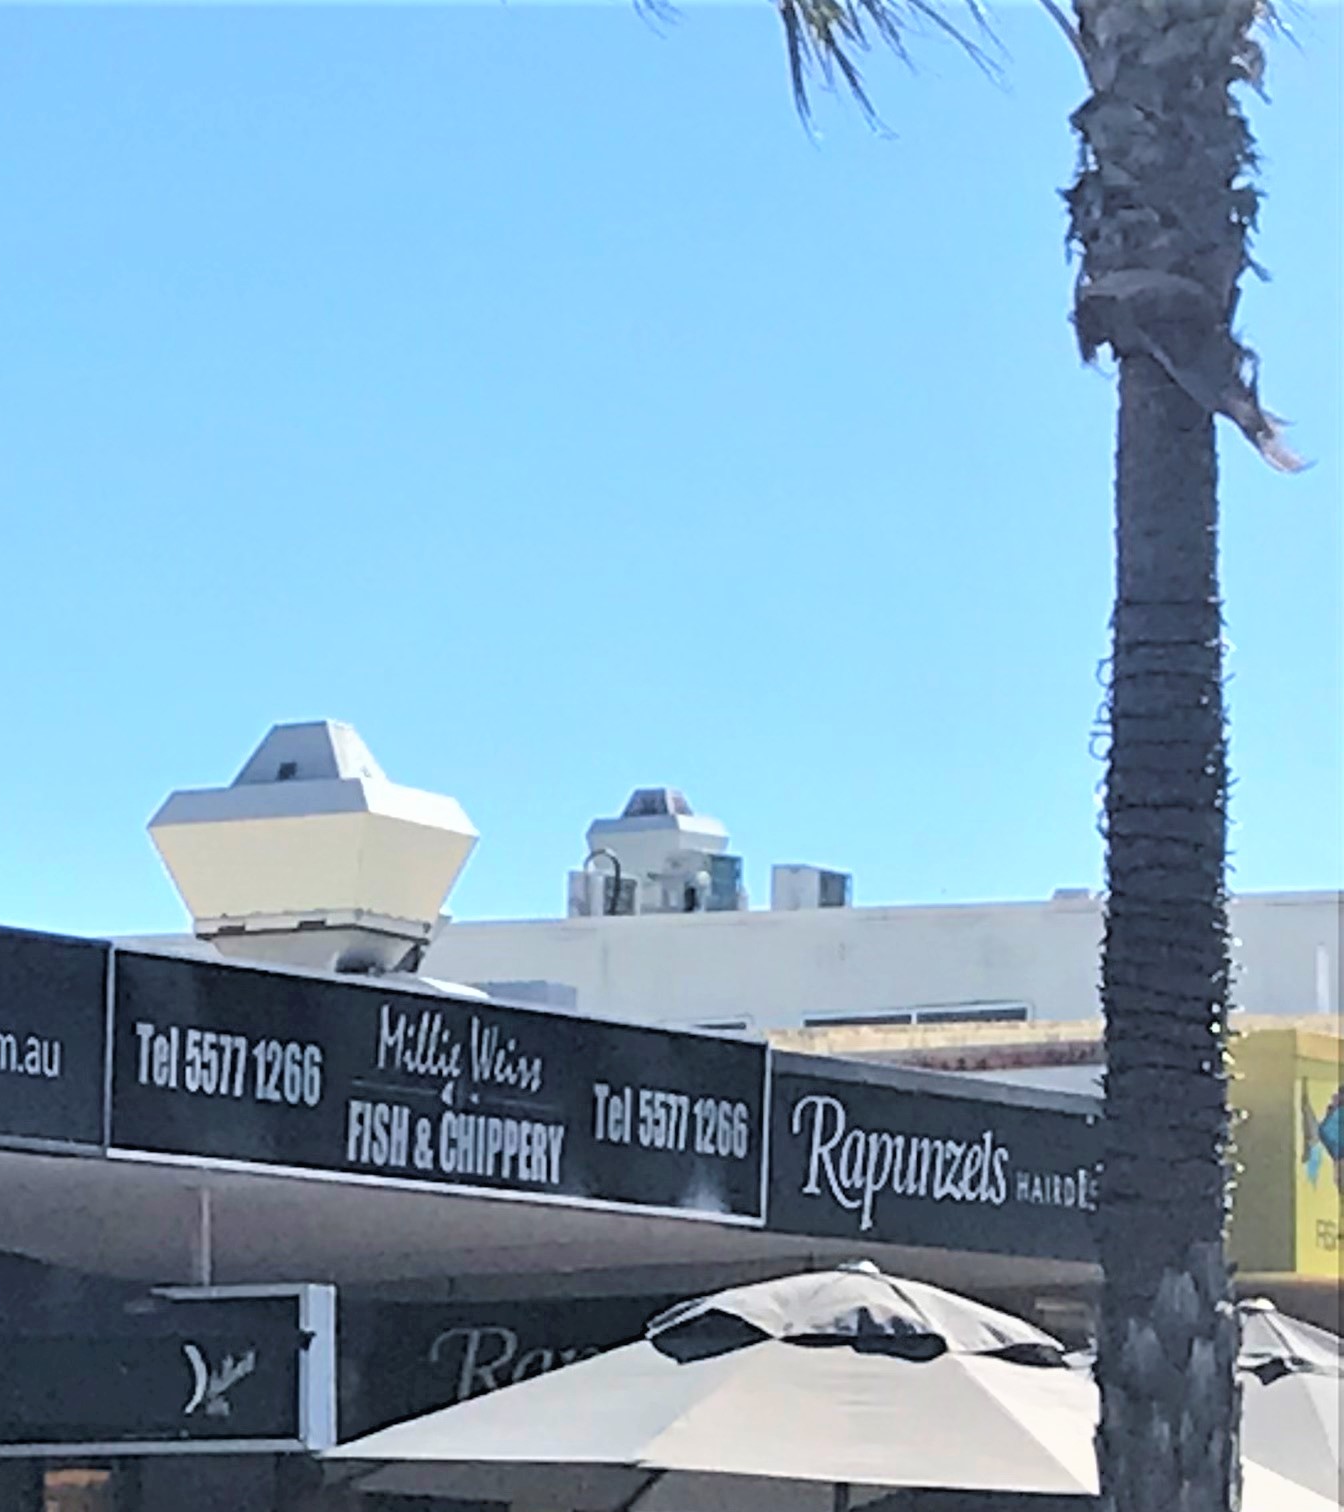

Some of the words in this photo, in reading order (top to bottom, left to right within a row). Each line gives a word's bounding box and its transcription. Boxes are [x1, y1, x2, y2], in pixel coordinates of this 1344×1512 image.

[136, 1022, 180, 1088] Tel
[185, 1028, 248, 1098] 5577
[253, 1039, 322, 1107] 1266
[378, 1004, 461, 1078] Millie
[348, 1100, 410, 1168] FISH
[414, 1117, 434, 1170] &
[439, 1110, 565, 1185] CHIPPERY
[593, 1083, 632, 1144] Tel
[639, 1089, 690, 1150] 5577
[693, 1097, 748, 1159] 1266
[792, 1095, 1009, 1230] Rapunzels
